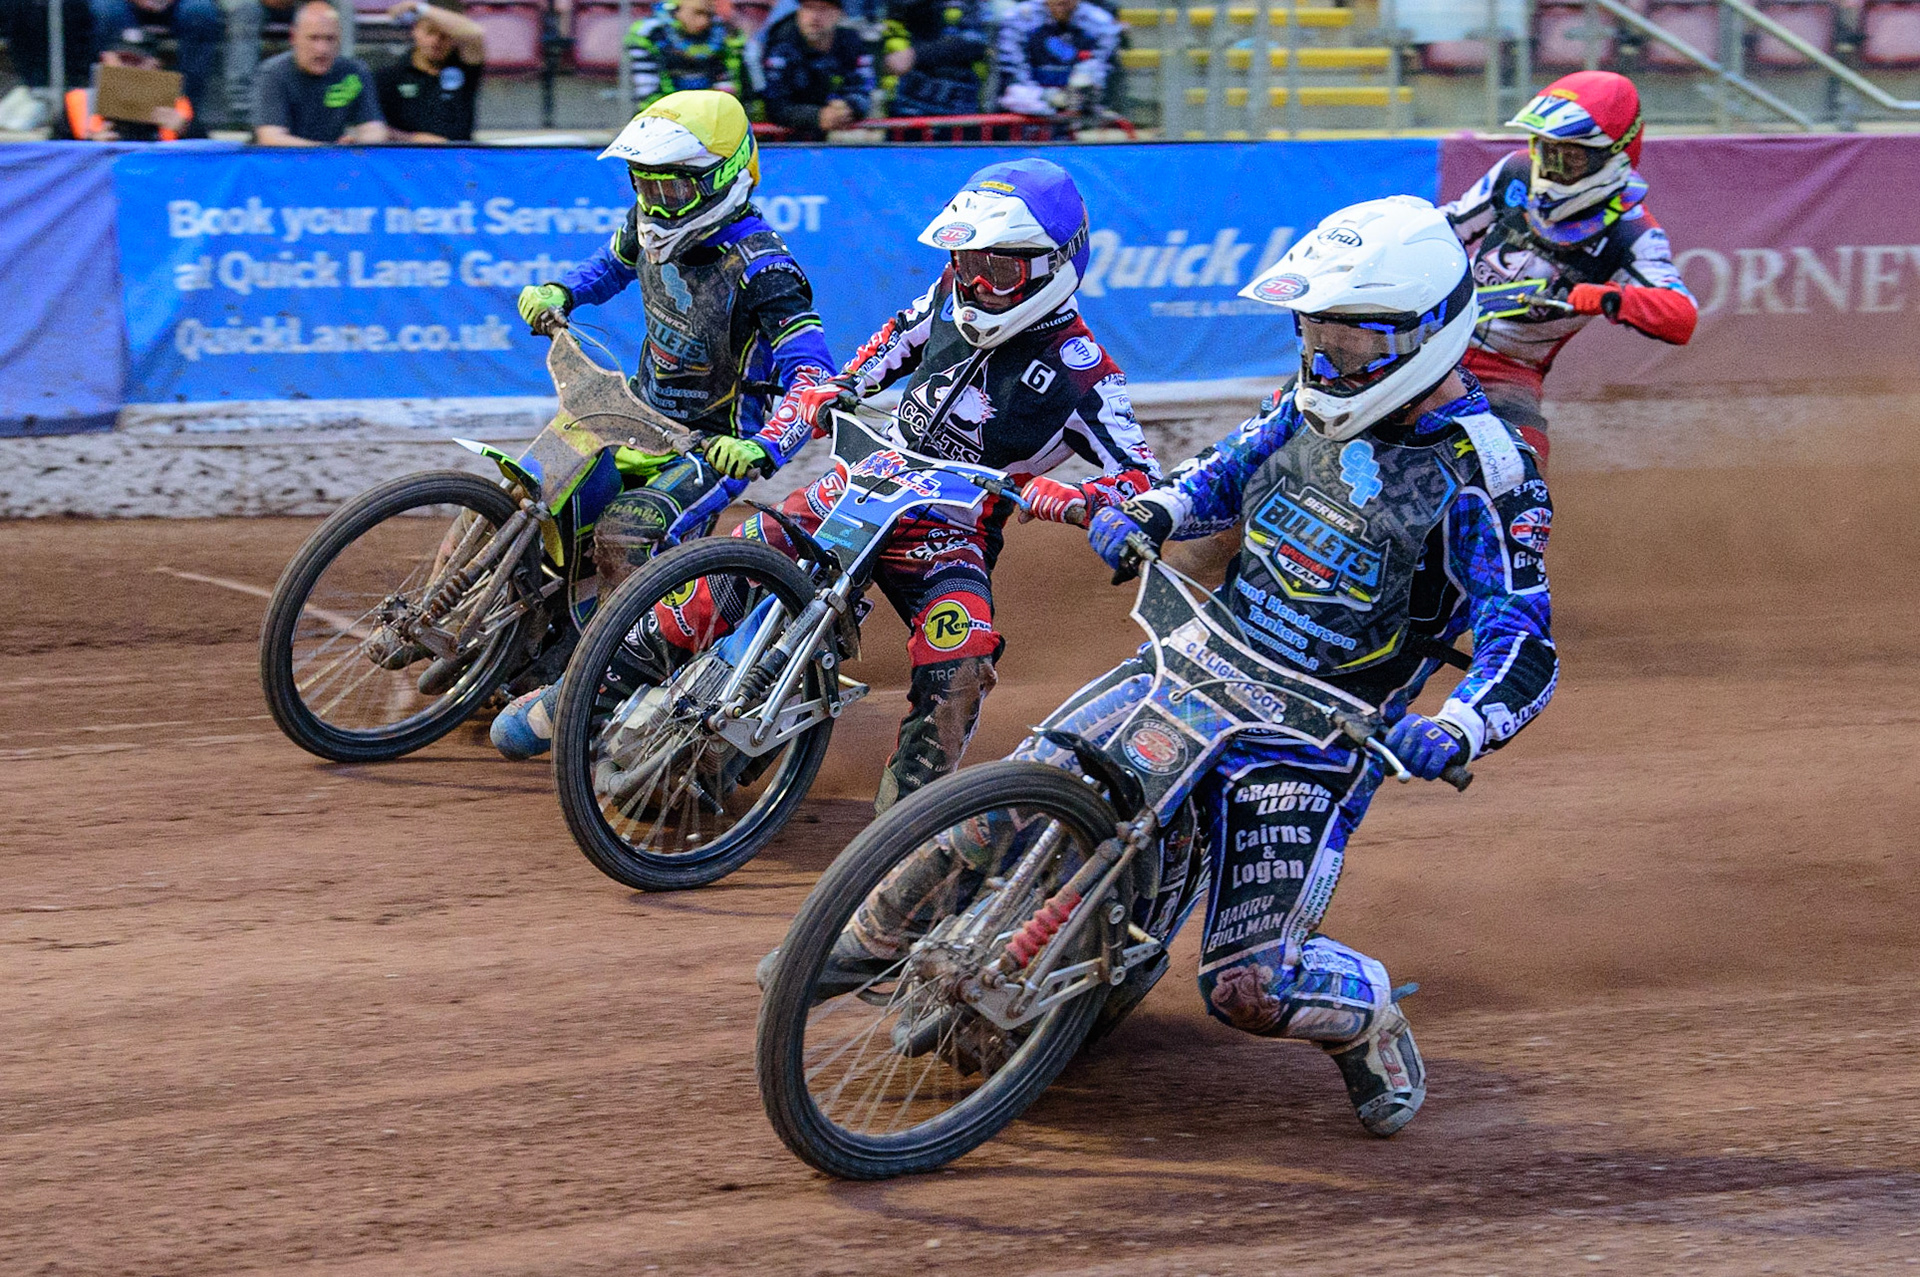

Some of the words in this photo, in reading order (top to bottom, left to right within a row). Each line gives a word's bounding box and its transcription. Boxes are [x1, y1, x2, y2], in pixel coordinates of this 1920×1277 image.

[167, 197, 276, 238] Book
[280, 206, 378, 242] your
[384, 202, 476, 234] next
[1325, 227, 1358, 247] Arai
[174, 255, 214, 291] at
[218, 251, 341, 296] Quick
[349, 251, 450, 288] Lane
[175, 315, 513, 362] QuickLane.co.uk
[1072, 340, 1093, 361] ATPI
[1302, 496, 1360, 534] BERWICK
[1260, 498, 1377, 576] BULLETS
[1279, 543, 1335, 580] SPEEDWAY
[1284, 560, 1323, 586] TEAM
[1235, 577, 1267, 605] rant
[1265, 595, 1358, 651] Henderson
[1247, 604, 1309, 650] Tankers
[1411, 718, 1457, 751] FOX
[1232, 780, 1333, 804] GRAHAM
[1255, 794, 1330, 815] LLOYD
[1234, 823, 1313, 852] Cairns
[1262, 845, 1277, 860] &
[1232, 858, 1305, 890] Logan
[1330, 857, 1341, 874] LTD
[1304, 876, 1325, 916] JACKSON
